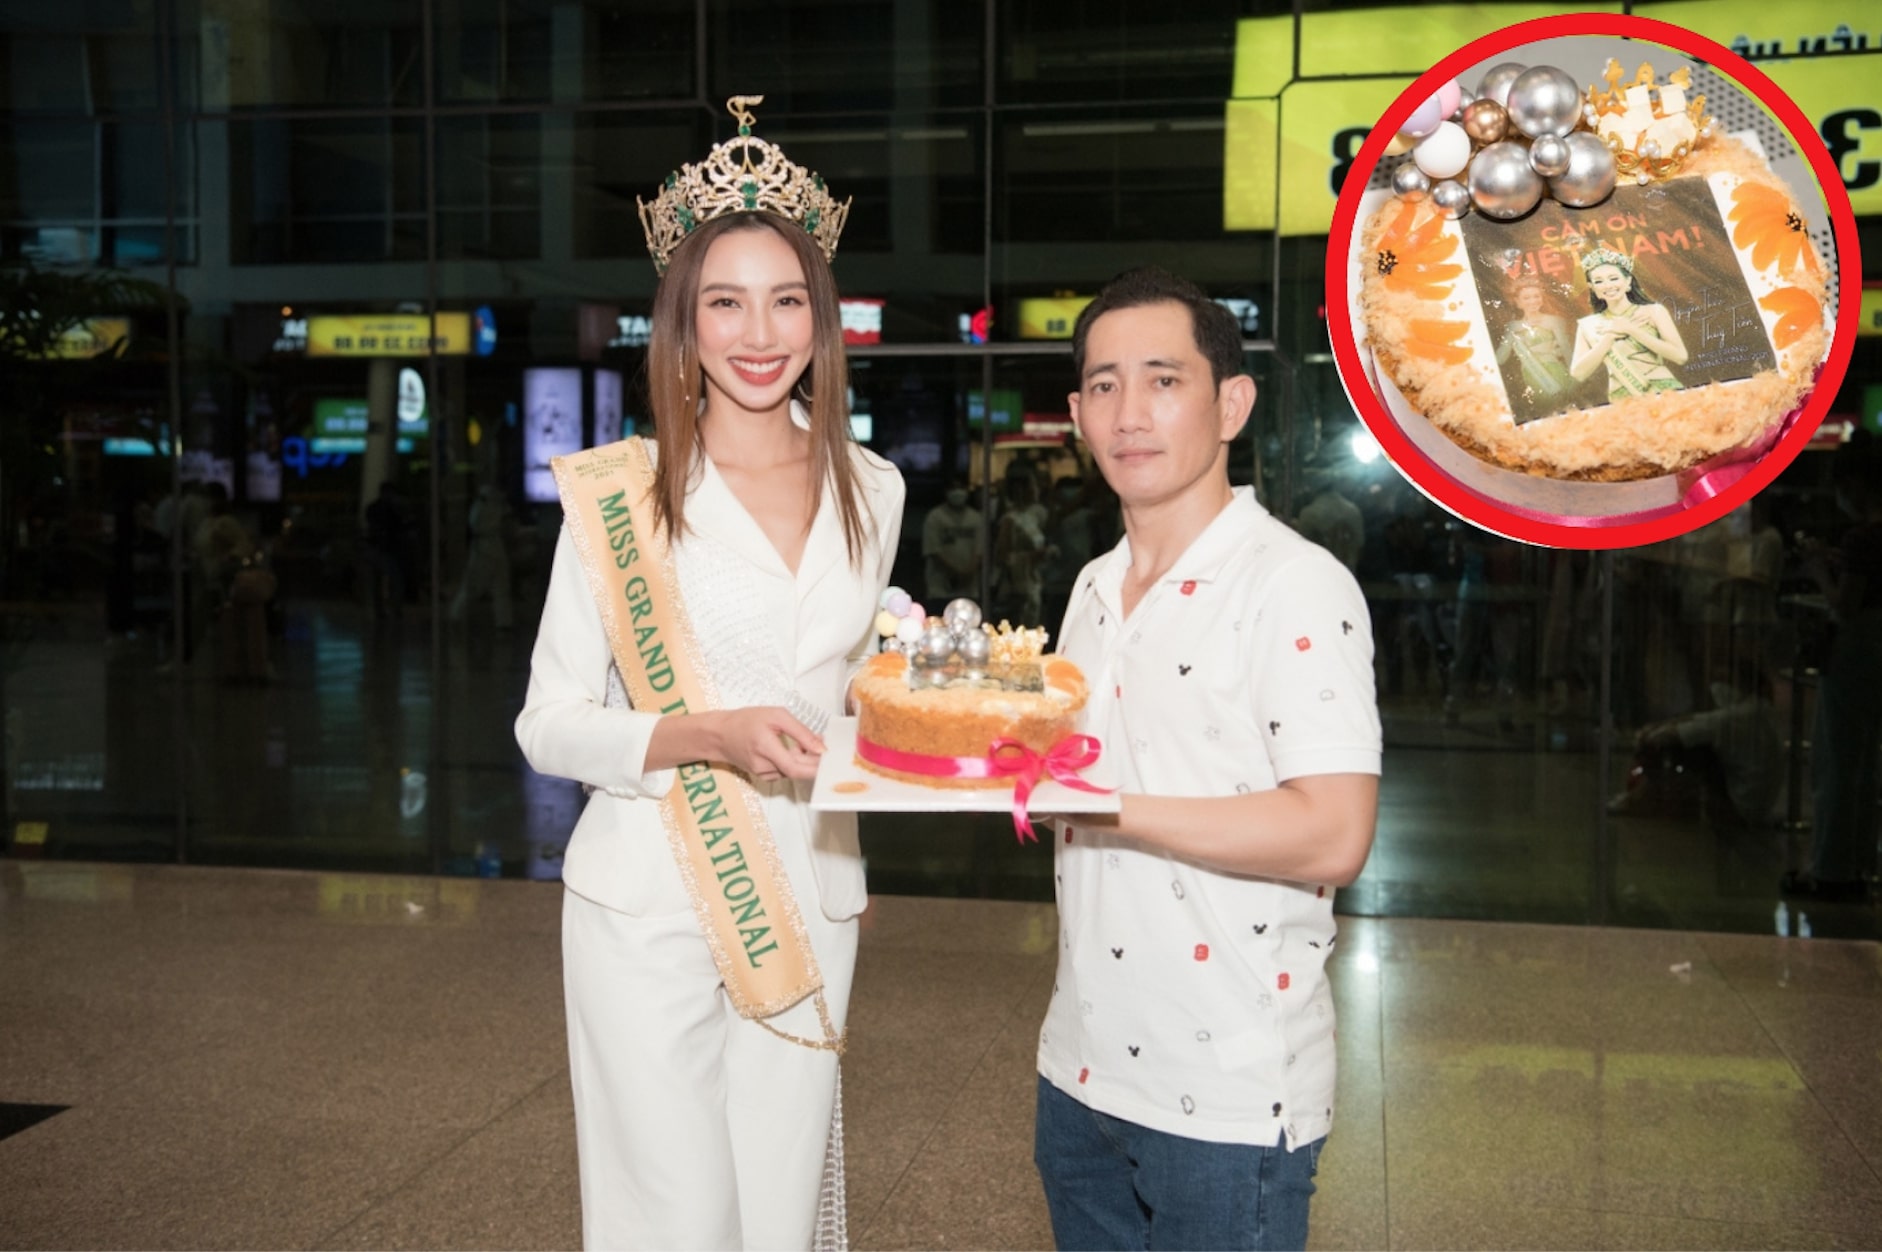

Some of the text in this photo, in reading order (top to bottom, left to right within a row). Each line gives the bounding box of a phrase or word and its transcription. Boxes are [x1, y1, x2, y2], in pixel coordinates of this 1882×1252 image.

[597, 488, 639, 570] MISS
[624, 576, 676, 693] GRAND
[659, 697, 780, 969] IERNATIONAL
